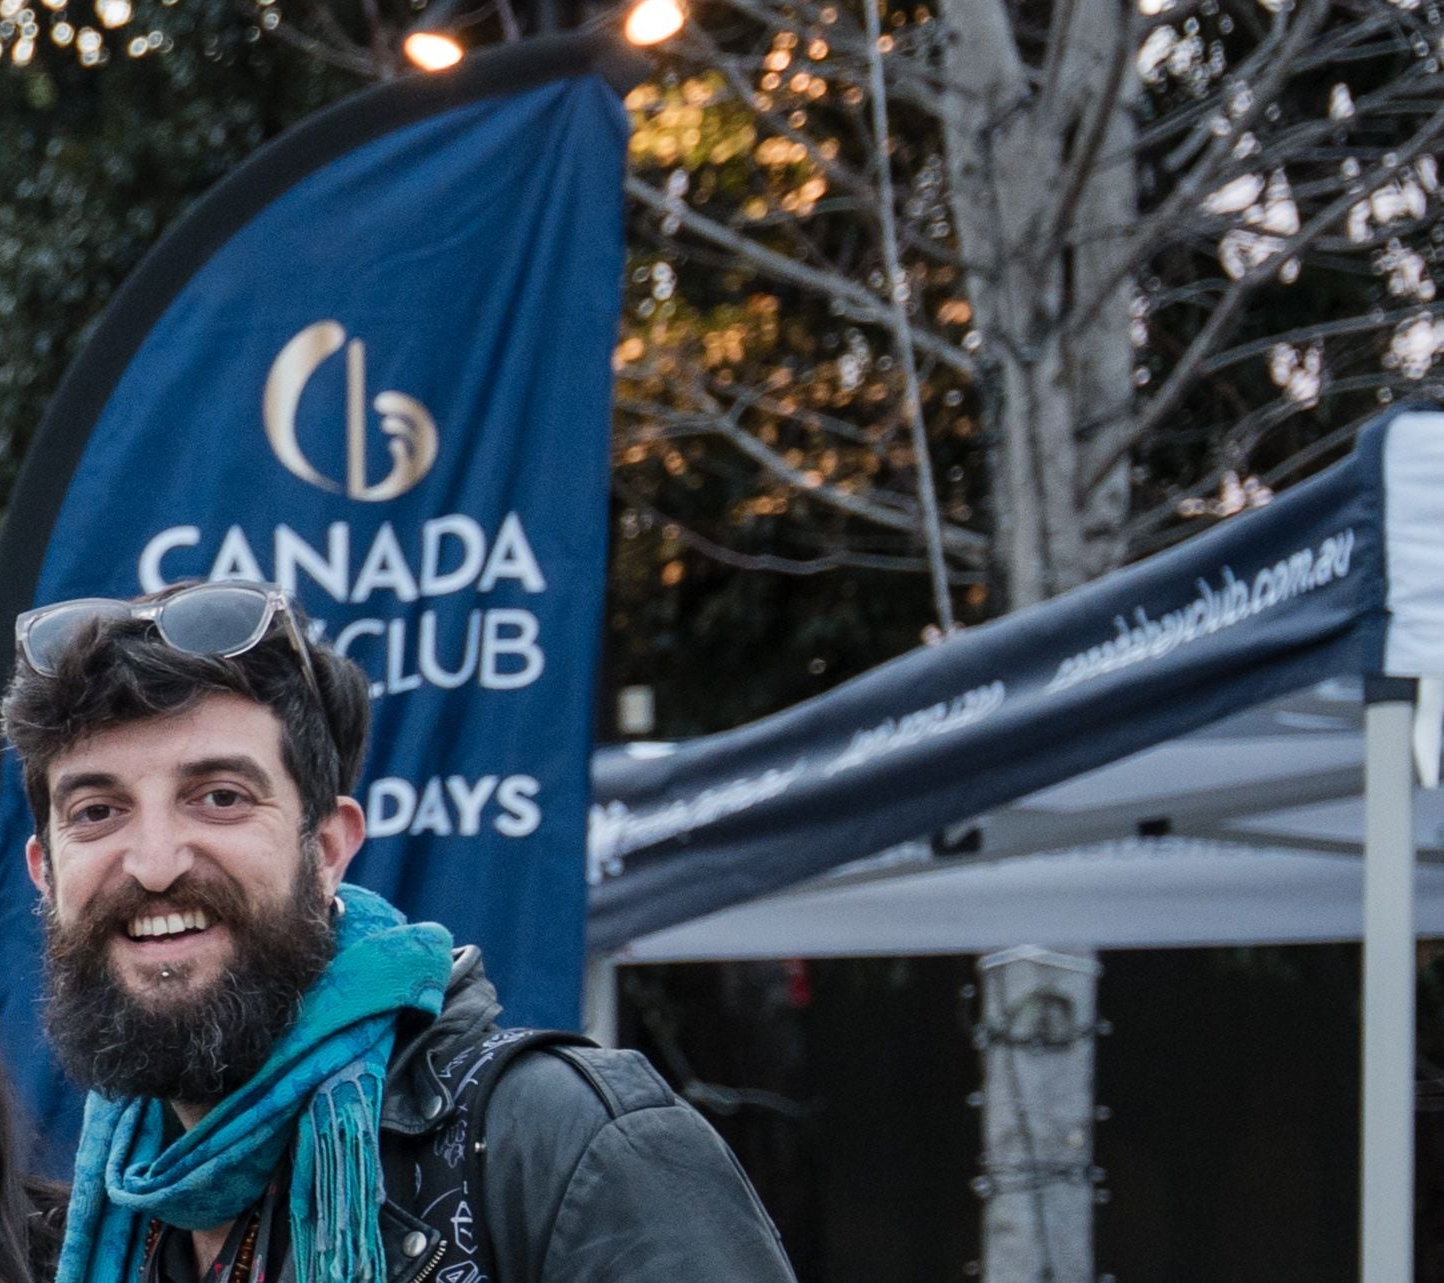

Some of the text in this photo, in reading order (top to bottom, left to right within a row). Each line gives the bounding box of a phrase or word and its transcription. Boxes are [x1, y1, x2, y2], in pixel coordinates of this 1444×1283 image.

[139, 511, 546, 603] CANADA
[310, 608, 545, 698] CLUB
[366, 774, 542, 838] DAYS
